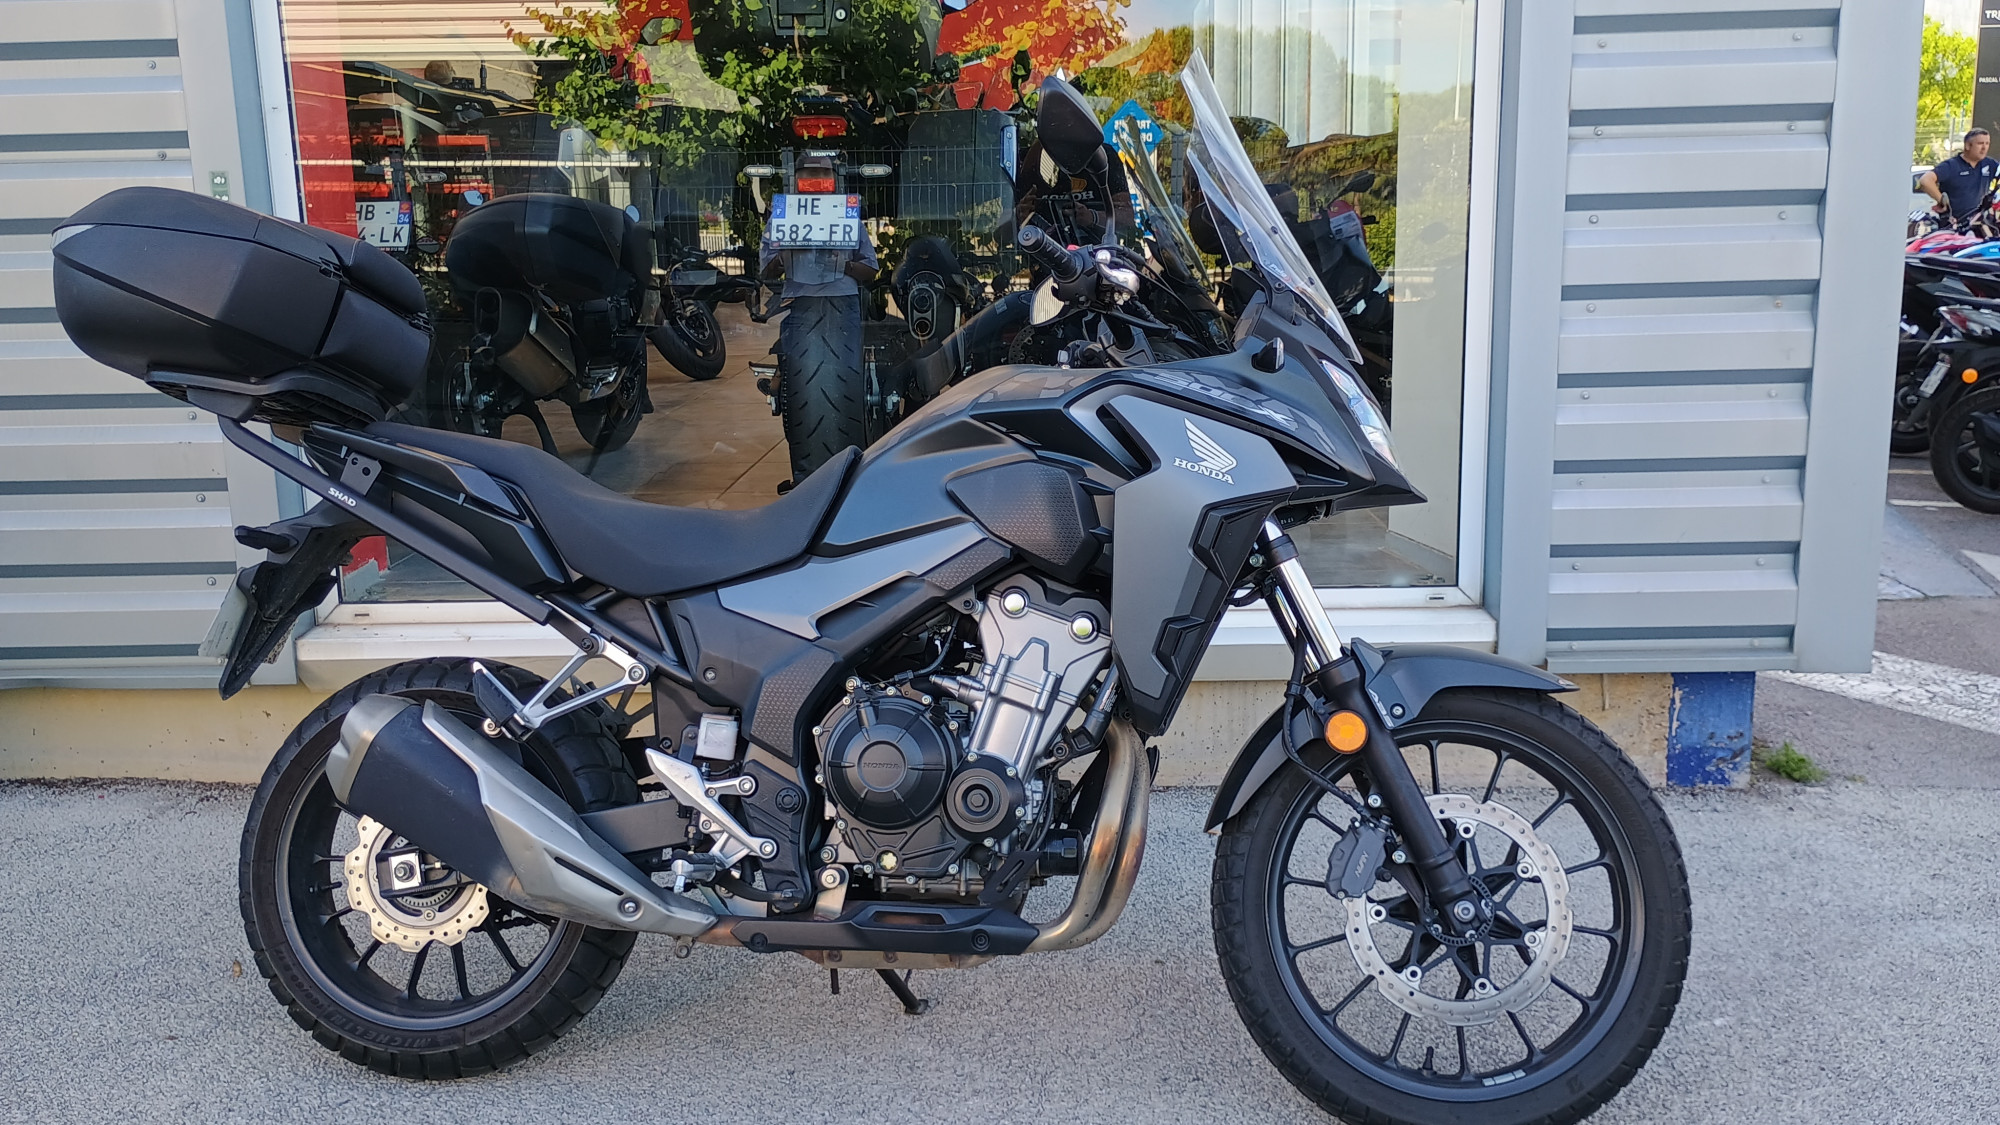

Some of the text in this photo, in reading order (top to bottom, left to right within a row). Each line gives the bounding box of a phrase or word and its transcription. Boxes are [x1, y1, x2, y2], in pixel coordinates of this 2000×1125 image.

[776, 208, 782, 216] F
[797, 198, 821, 215] HE
[846, 207, 858, 217] 34
[398, 213, 410, 223] 34
[1173, 457, 1235, 485] HONDA
[328, 487, 357, 507] SHAD
[1368, 688, 1395, 728] ABS
[863, 762, 903, 770] HONDA
[331, 1013, 432, 1049] MICHELIN
